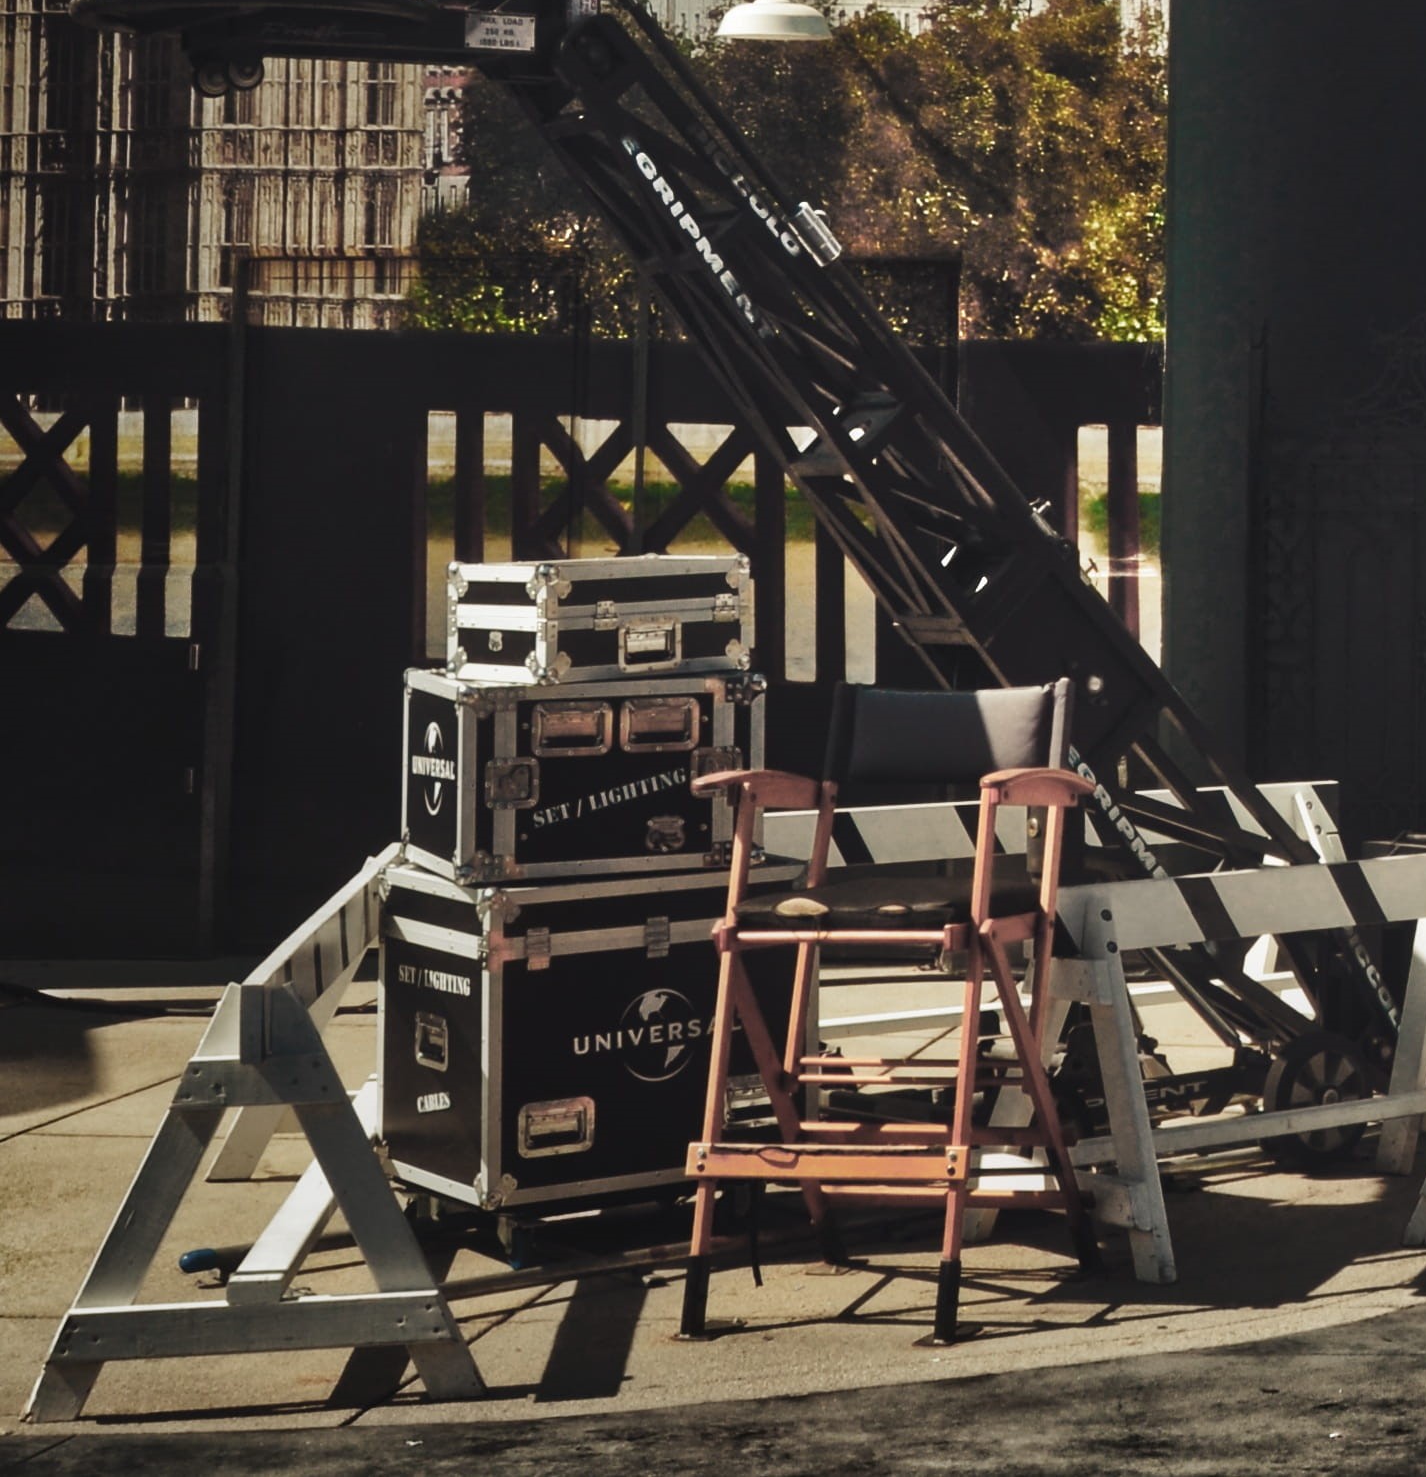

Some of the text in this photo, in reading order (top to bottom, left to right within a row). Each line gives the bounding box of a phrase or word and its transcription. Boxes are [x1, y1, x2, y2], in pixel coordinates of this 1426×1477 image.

[412, 755, 456, 780] UNIVERSAL
[532, 802, 571, 829] SET
[588, 767, 687, 811] LIGHTING
[398, 964, 417, 985] SET
[424, 968, 471, 997] LIGHTING
[417, 1091, 451, 1113] CABLES
